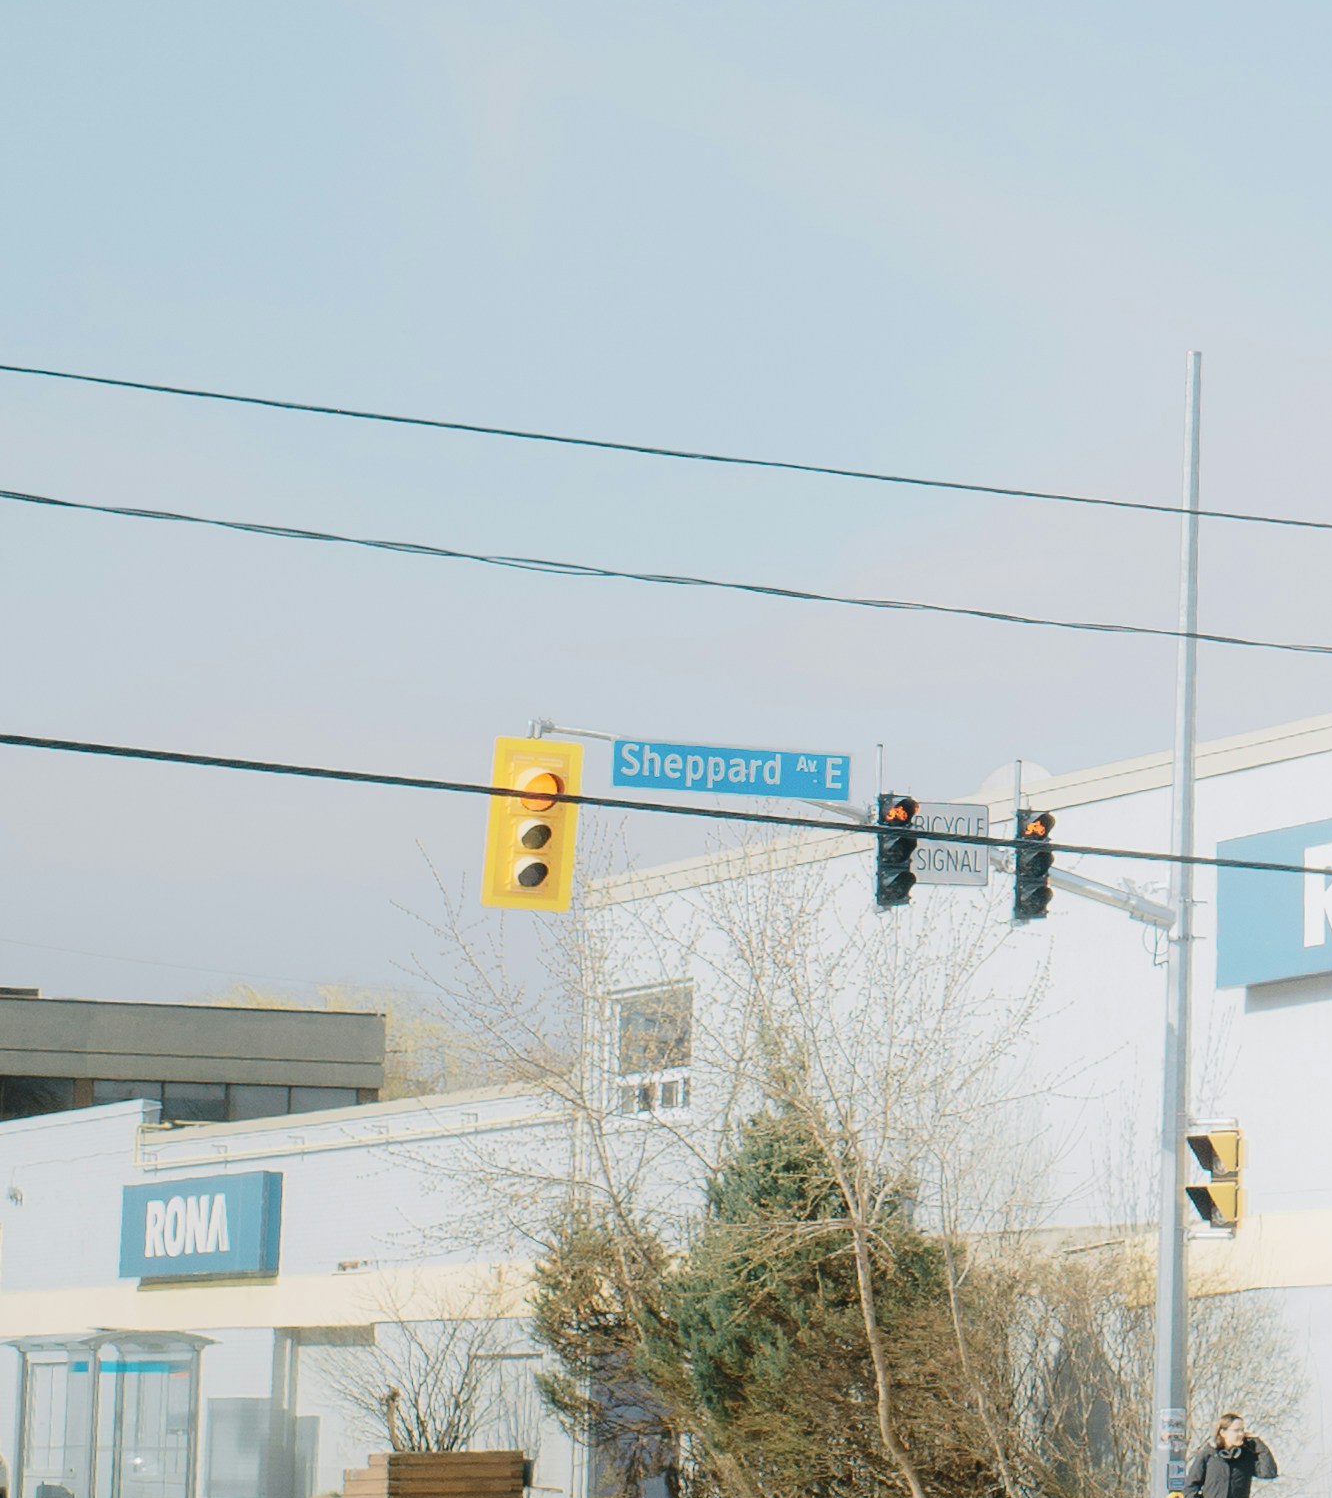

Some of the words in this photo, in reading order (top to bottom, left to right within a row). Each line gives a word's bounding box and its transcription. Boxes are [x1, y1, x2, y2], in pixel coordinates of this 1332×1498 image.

[620, 743, 781, 788] Sheppard
[826, 758, 842, 789] E
[916, 848, 982, 873] SIGNAL
[144, 1193, 230, 1258] RONA
